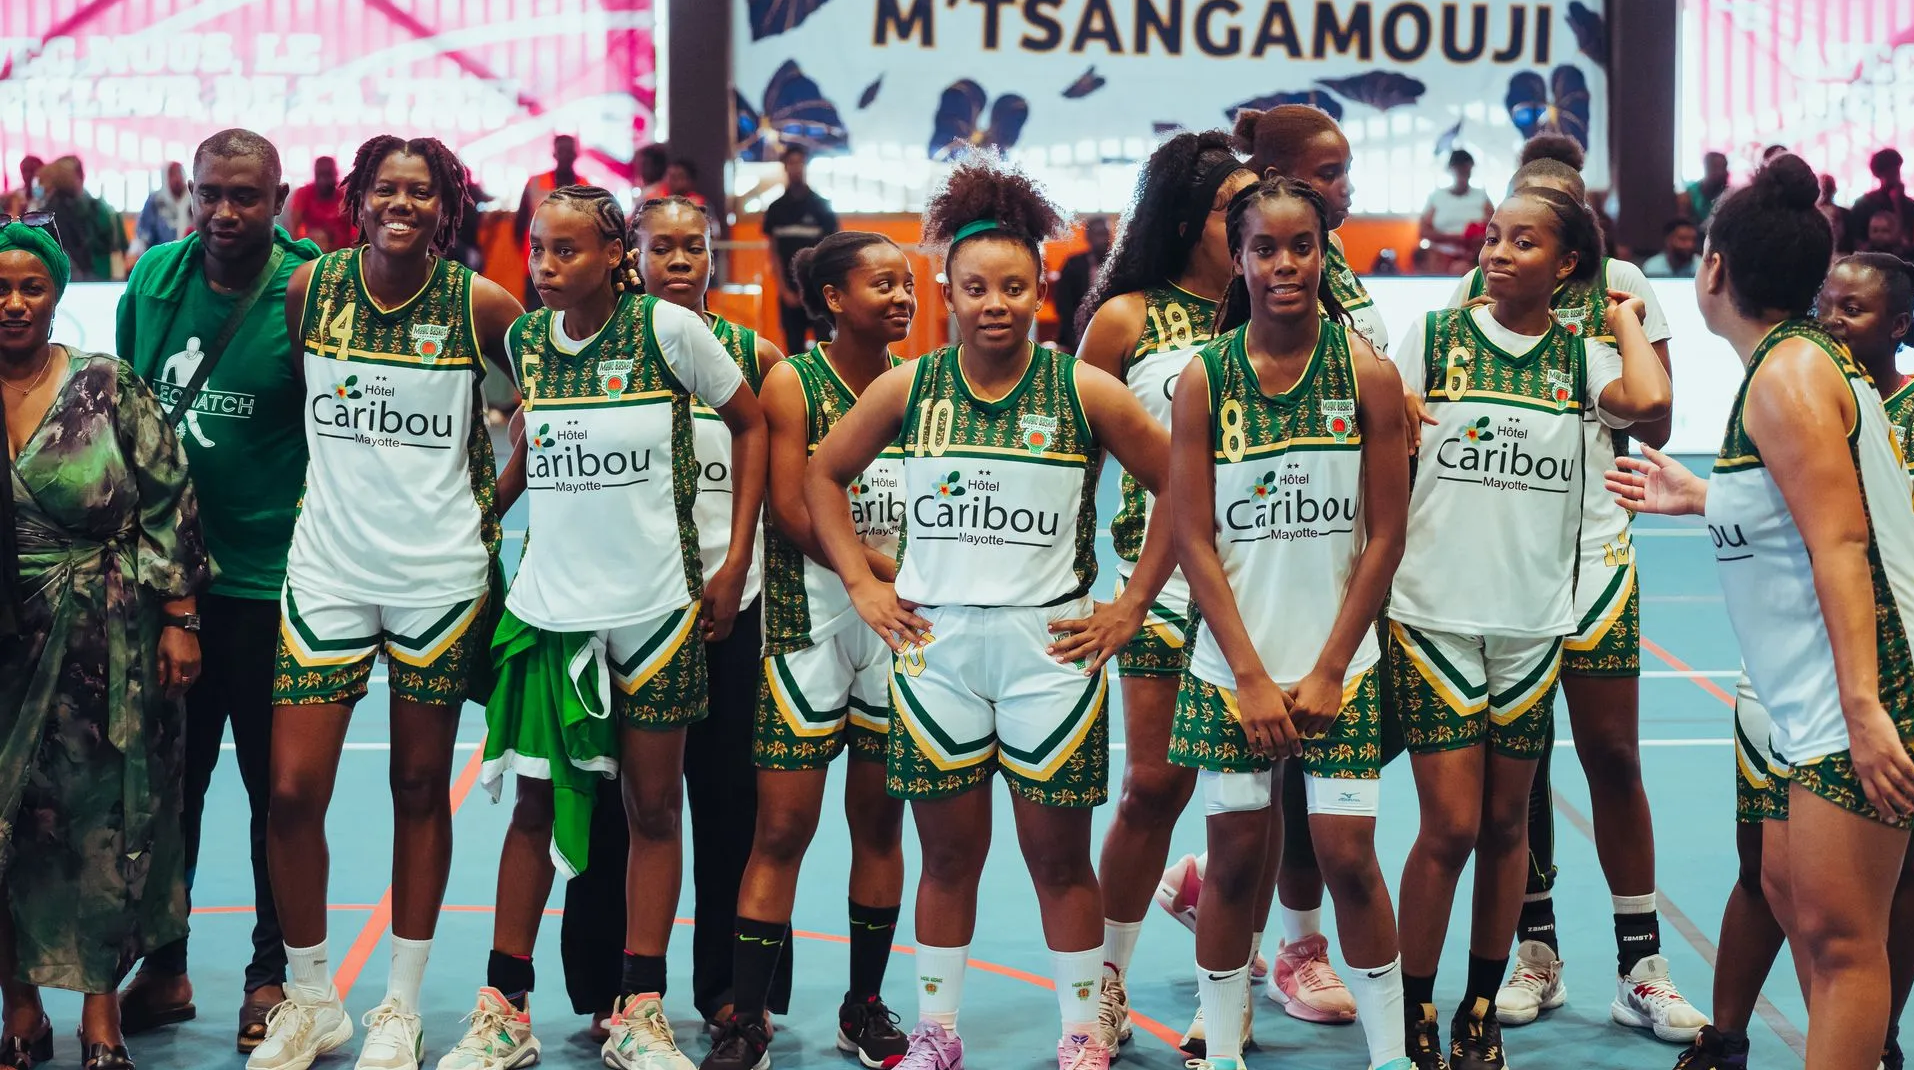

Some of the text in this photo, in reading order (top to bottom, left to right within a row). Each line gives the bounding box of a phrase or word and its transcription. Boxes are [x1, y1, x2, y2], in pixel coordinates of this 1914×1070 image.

[317, 298, 356, 361] 14
[1147, 302, 1194, 353] 18
[522, 353, 540, 412] 5
[1444, 346, 1470, 402] 6
[364, 384, 395, 397] Hôtel
[312, 393, 452, 438] Caribou
[557, 429, 588, 441] Hôtel
[914, 398, 954, 458] 10
[1220, 398, 1248, 463] 8
[1497, 425, 1528, 439] Hôtel
[355, 433, 400, 448] Mayotte
[1437, 437, 1574, 482] Caribou
[556, 481, 601, 494] Mayotte
[871, 477, 898, 488] Hôtel
[967, 479, 1000, 492] Hôtel
[1280, 473, 1309, 485] Hôtel
[1482, 476, 1528, 491] Mayotte
[852, 491, 906, 524] arib
[914, 494, 1059, 537] Caribou
[1226, 489, 1358, 531] Caribou
[958, 532, 1004, 546] Mayotte
[1270, 527, 1318, 542] Mayotte
